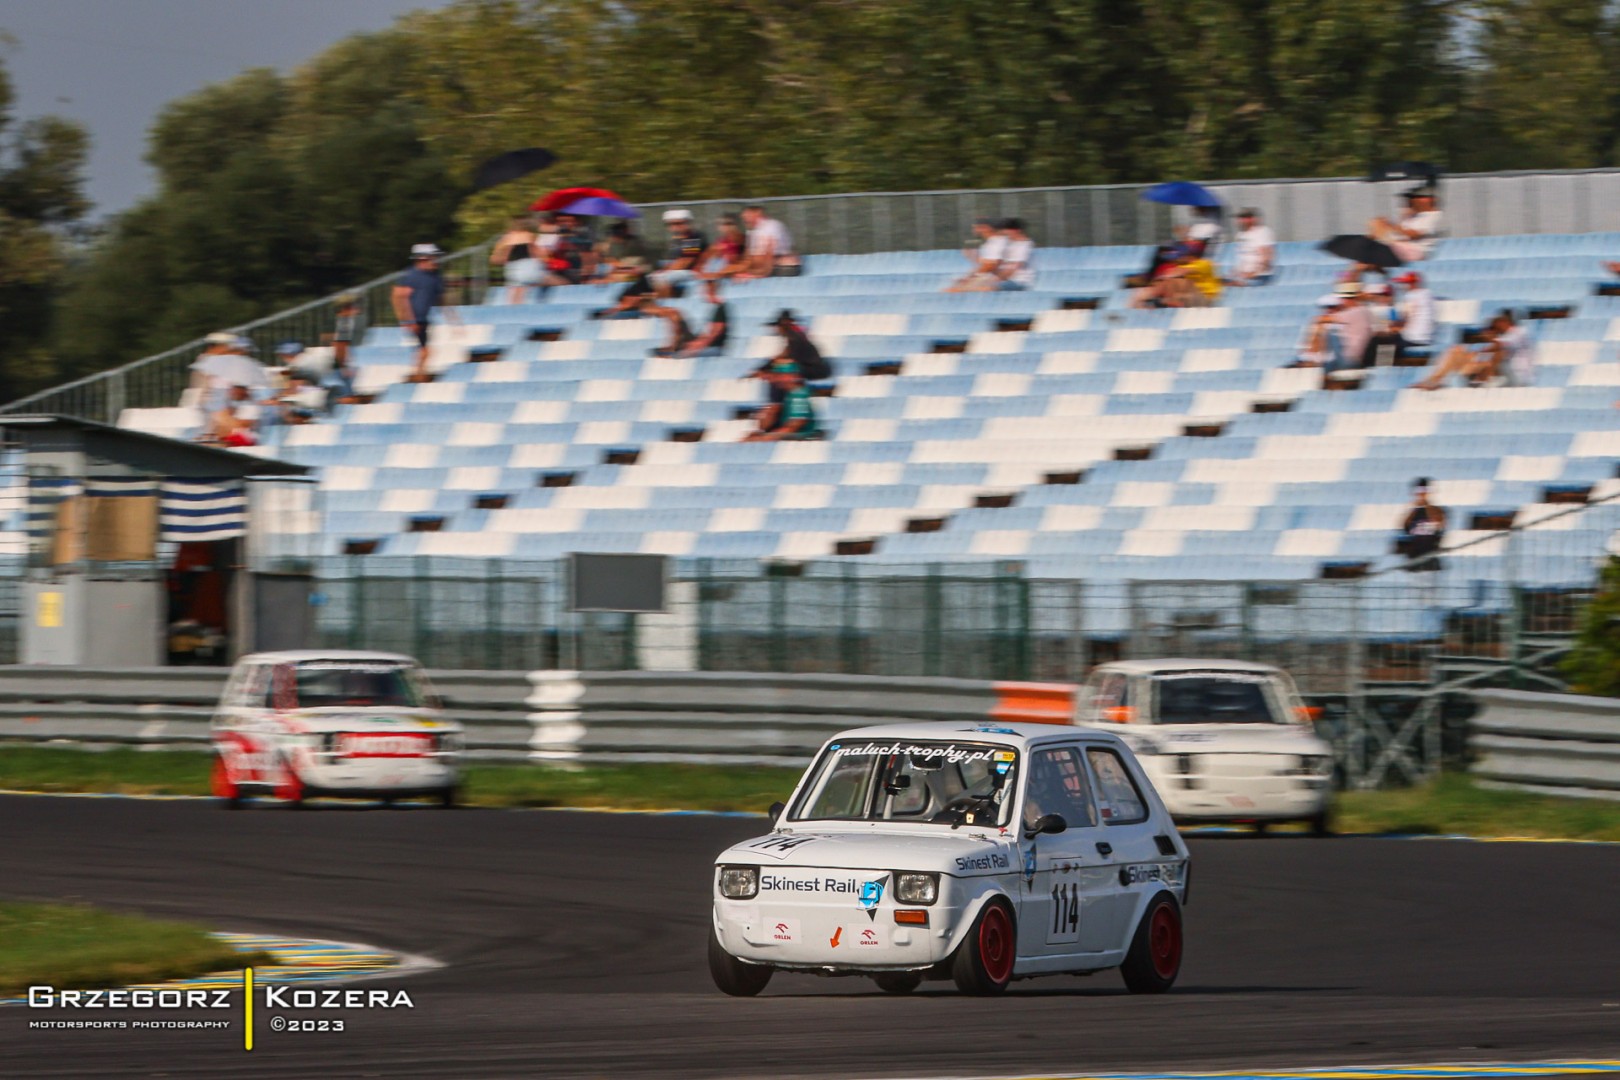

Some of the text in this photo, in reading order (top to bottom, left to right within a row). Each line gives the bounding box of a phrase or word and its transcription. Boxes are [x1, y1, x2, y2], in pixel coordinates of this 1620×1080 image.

[836, 742, 996, 765] maluch-trophy.pl
[748, 836, 817, 852] 114
[955, 853, 1010, 871] Skinest Rail
[761, 875, 856, 893] Skinest Rail
[1051, 882, 1079, 934] 114
